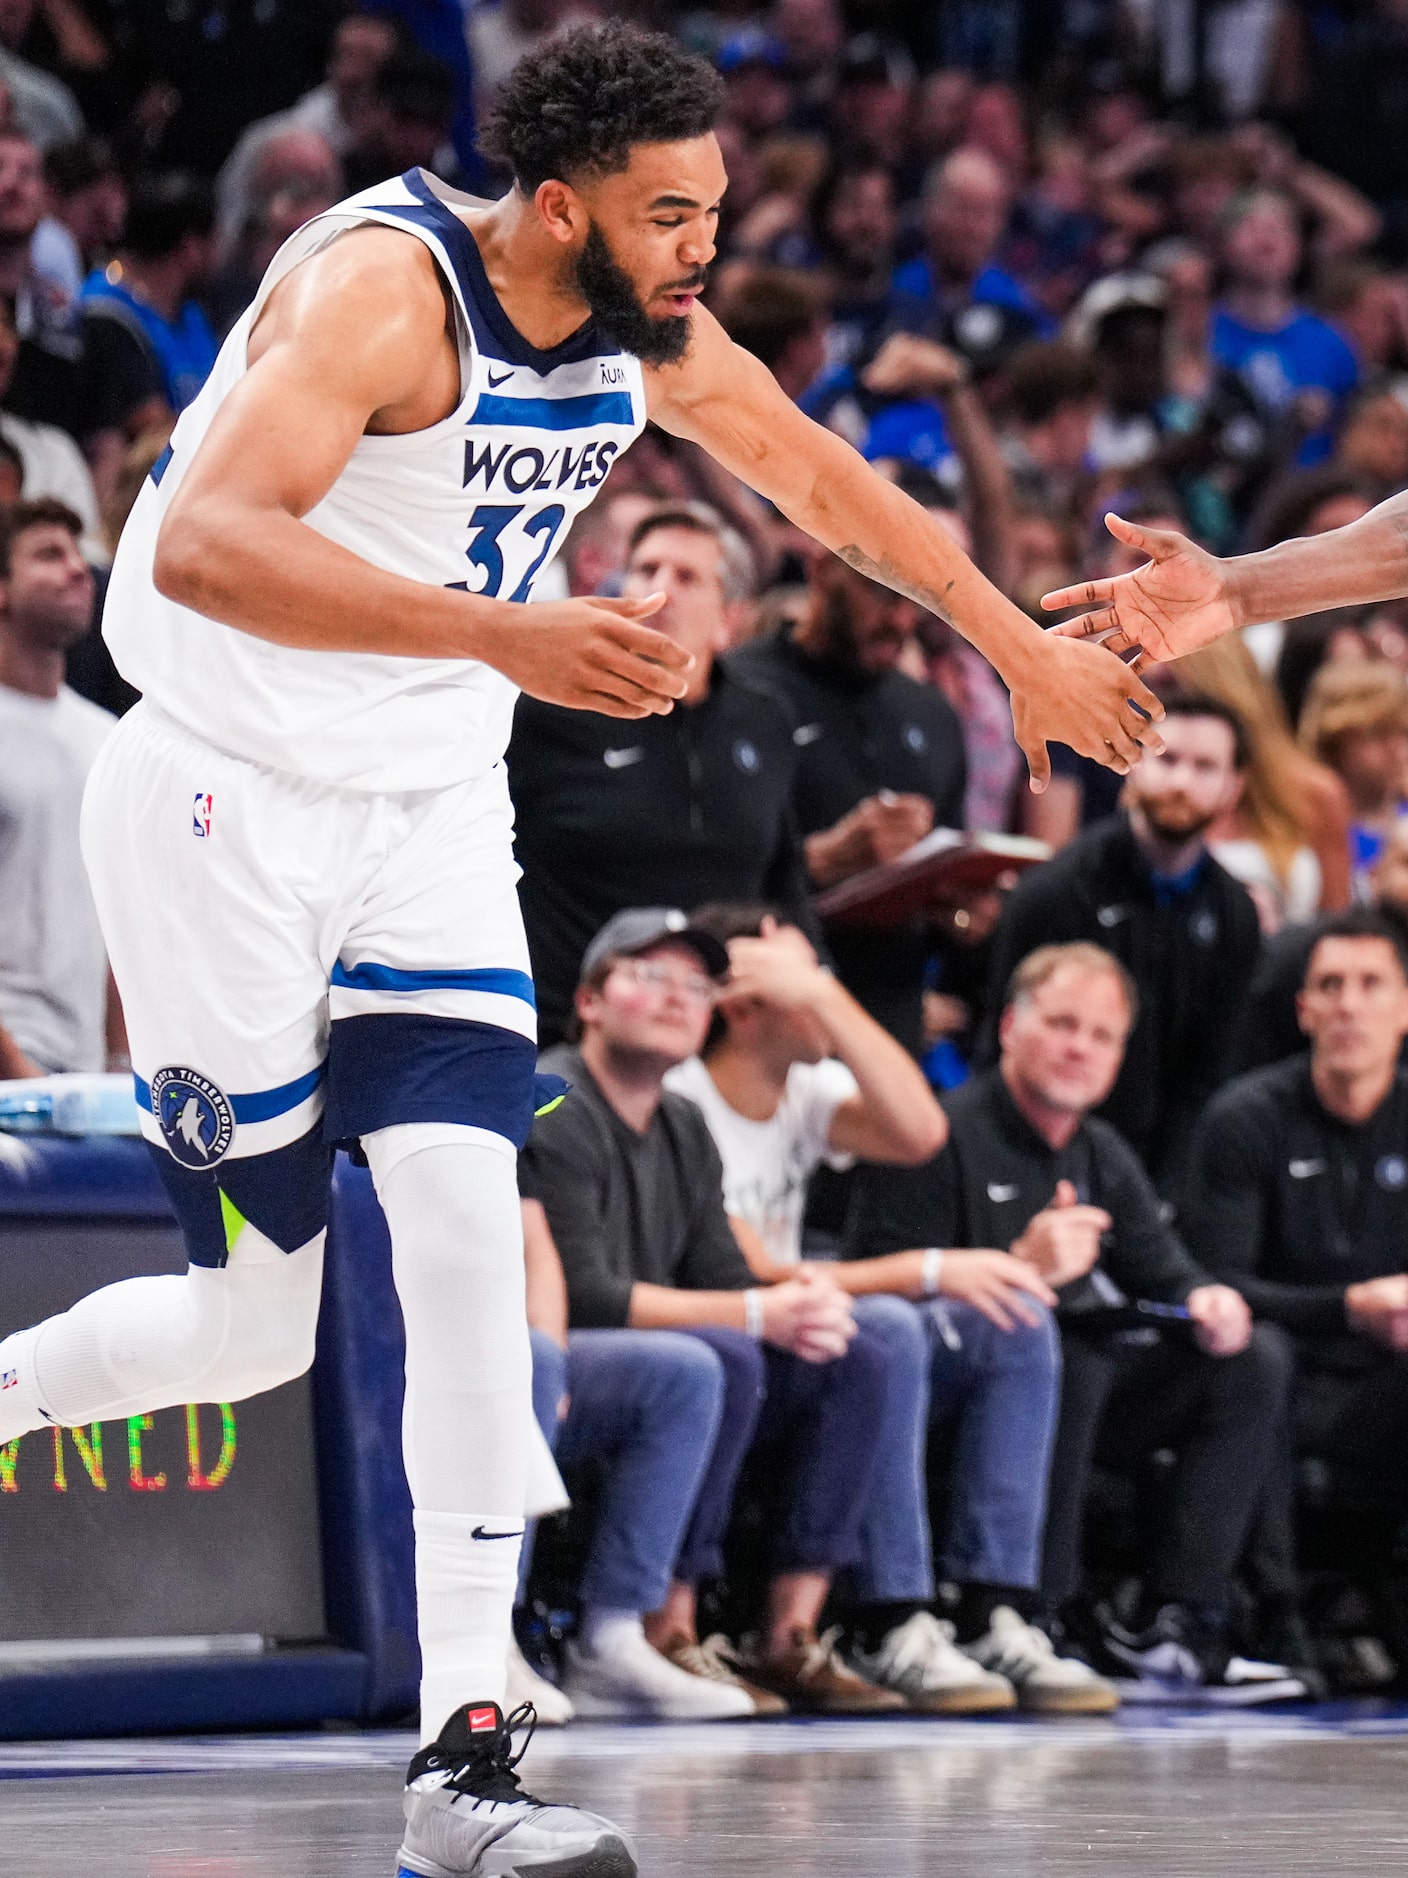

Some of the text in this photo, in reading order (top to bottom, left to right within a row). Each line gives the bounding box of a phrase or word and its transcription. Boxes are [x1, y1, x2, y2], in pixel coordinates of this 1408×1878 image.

[462, 439, 619, 494] WOLVES
[444, 503, 566, 604] 32
[179, 1069, 232, 1154] TIMBERWOLVES
